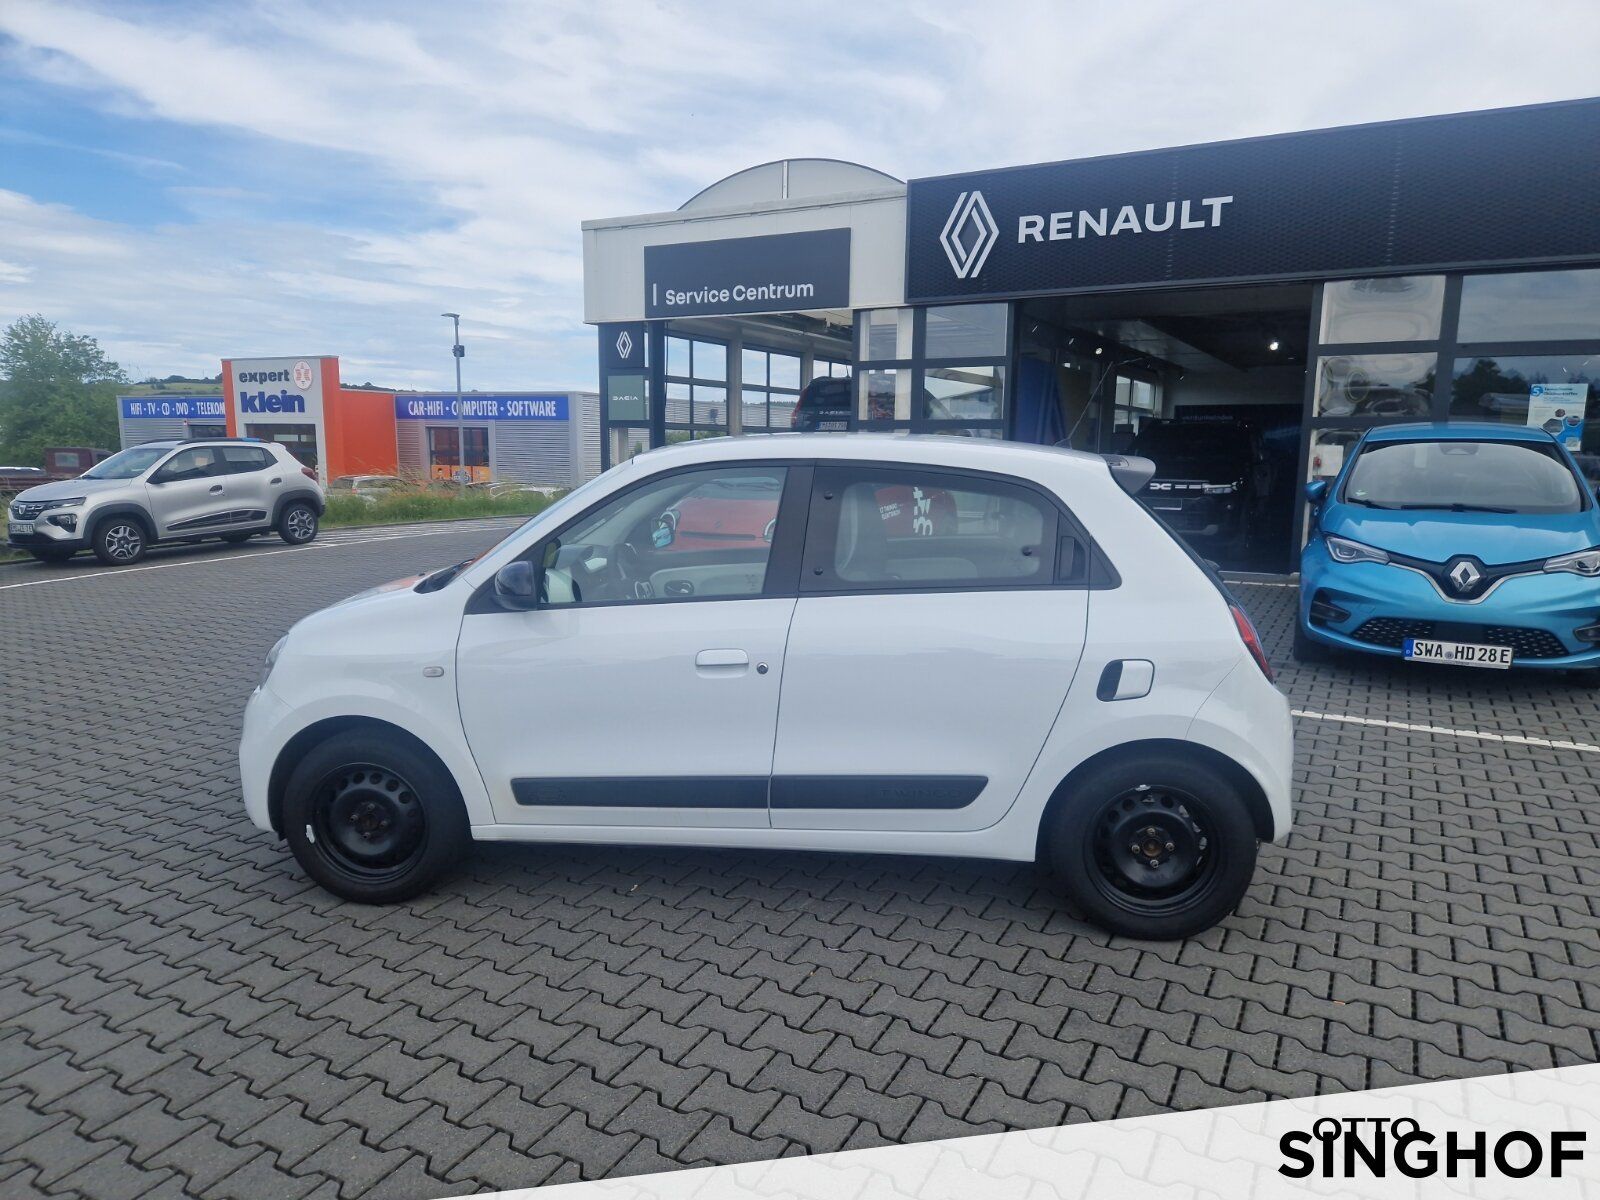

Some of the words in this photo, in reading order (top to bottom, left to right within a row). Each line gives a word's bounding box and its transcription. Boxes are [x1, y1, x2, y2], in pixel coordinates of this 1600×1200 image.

[1017, 195, 1234, 244] RENAULT
[665, 286, 730, 306] Service
[732, 283, 814, 301] Centrum
[239, 369, 290, 384] expert
[147, 402, 156, 415] TV
[161, 402, 170, 415] CD
[175, 402, 189, 415] DVD
[239, 389, 306, 413] klein
[407, 400, 444, 416] CAR-HIFI
[507, 400, 557, 417] SOFTWARE
[1413, 642, 1443, 658] SWA
